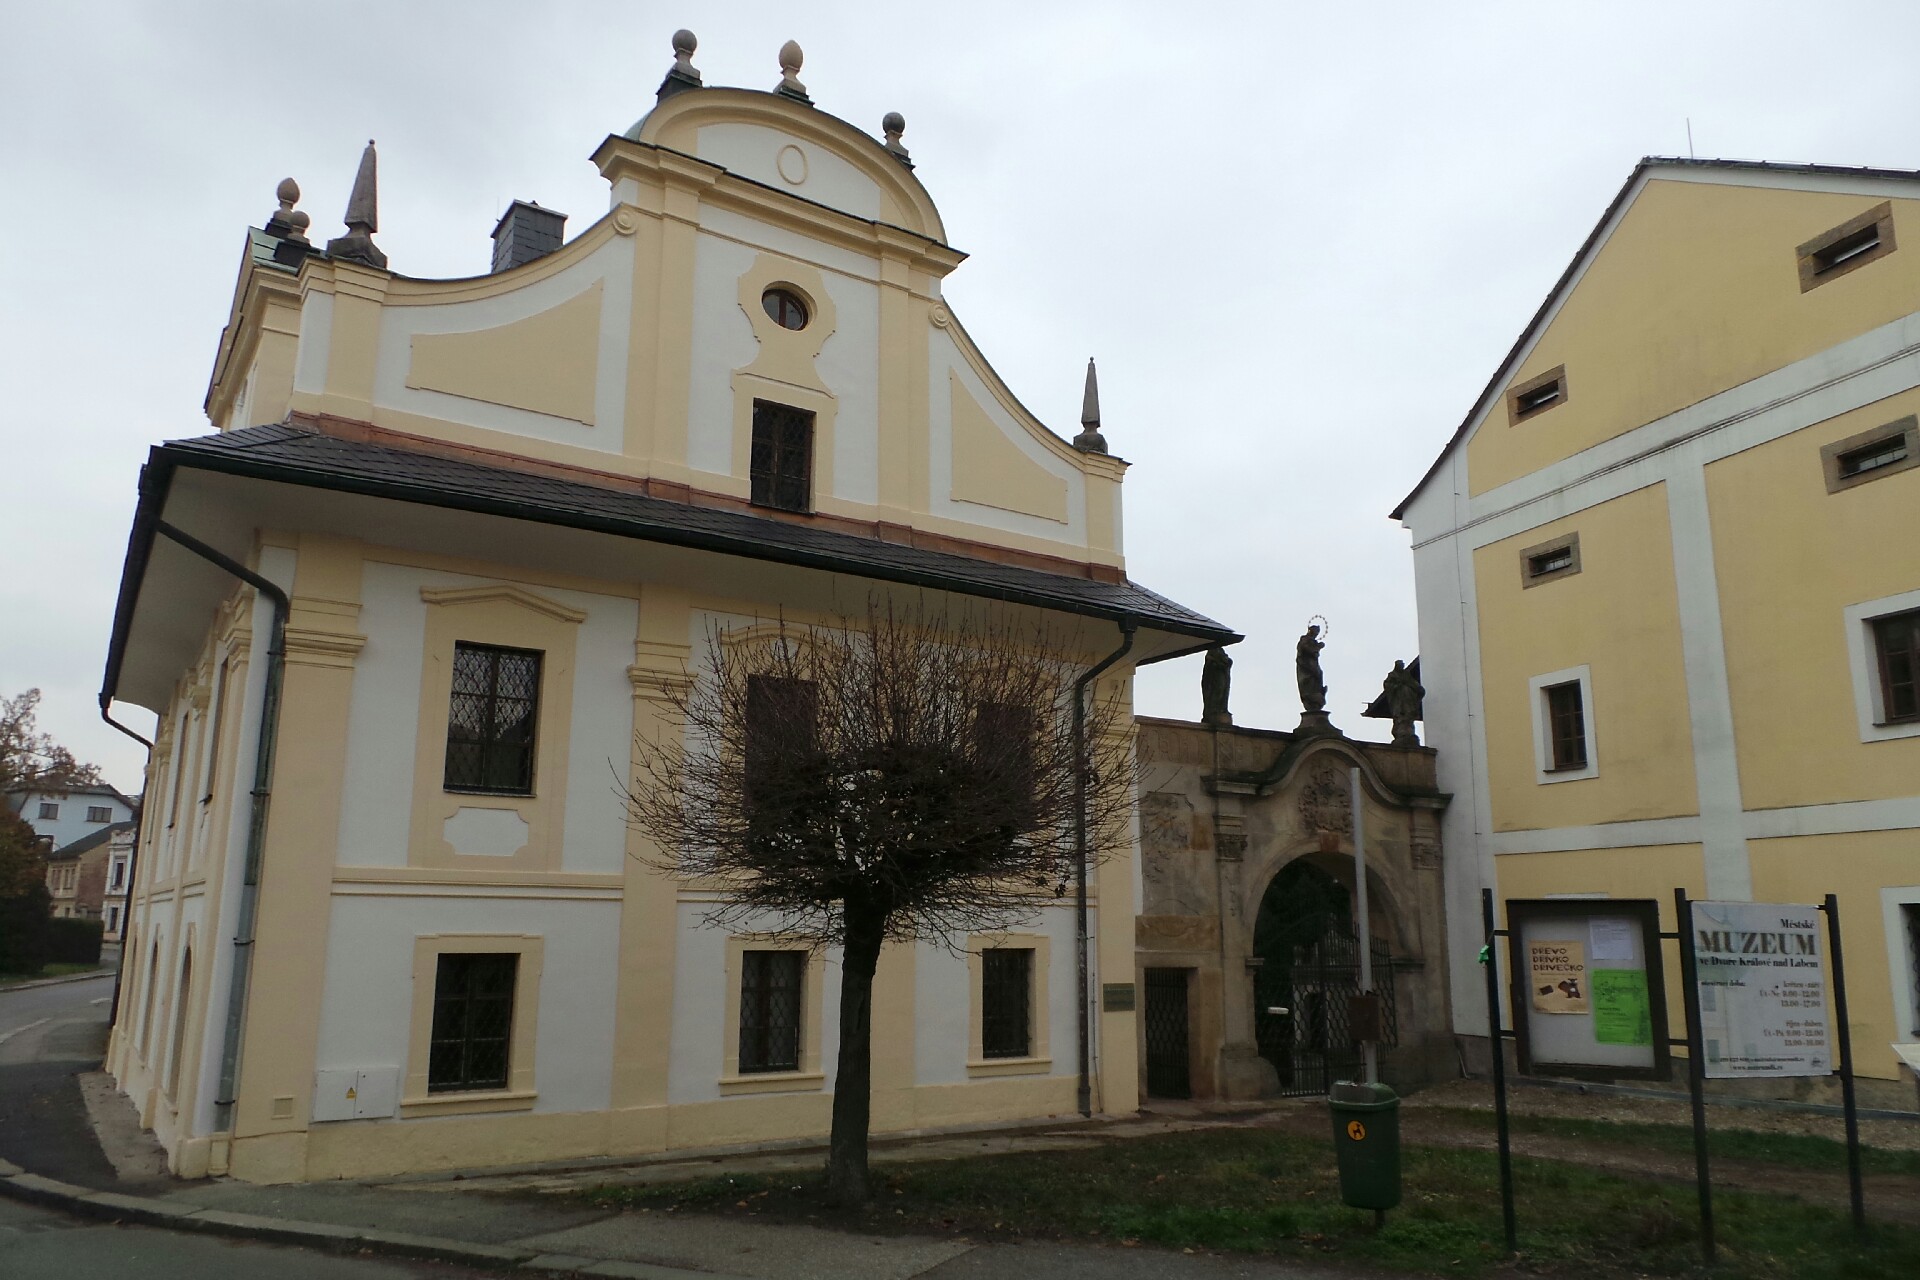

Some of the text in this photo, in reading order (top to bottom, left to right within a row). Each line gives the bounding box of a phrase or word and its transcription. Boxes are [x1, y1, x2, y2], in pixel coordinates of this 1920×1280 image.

[1698, 930, 1816, 955] MUZEUM
[1699, 958, 1709, 966] ve
[1773, 958, 1788, 967] nad
[1790, 958, 1818, 969] Labem
